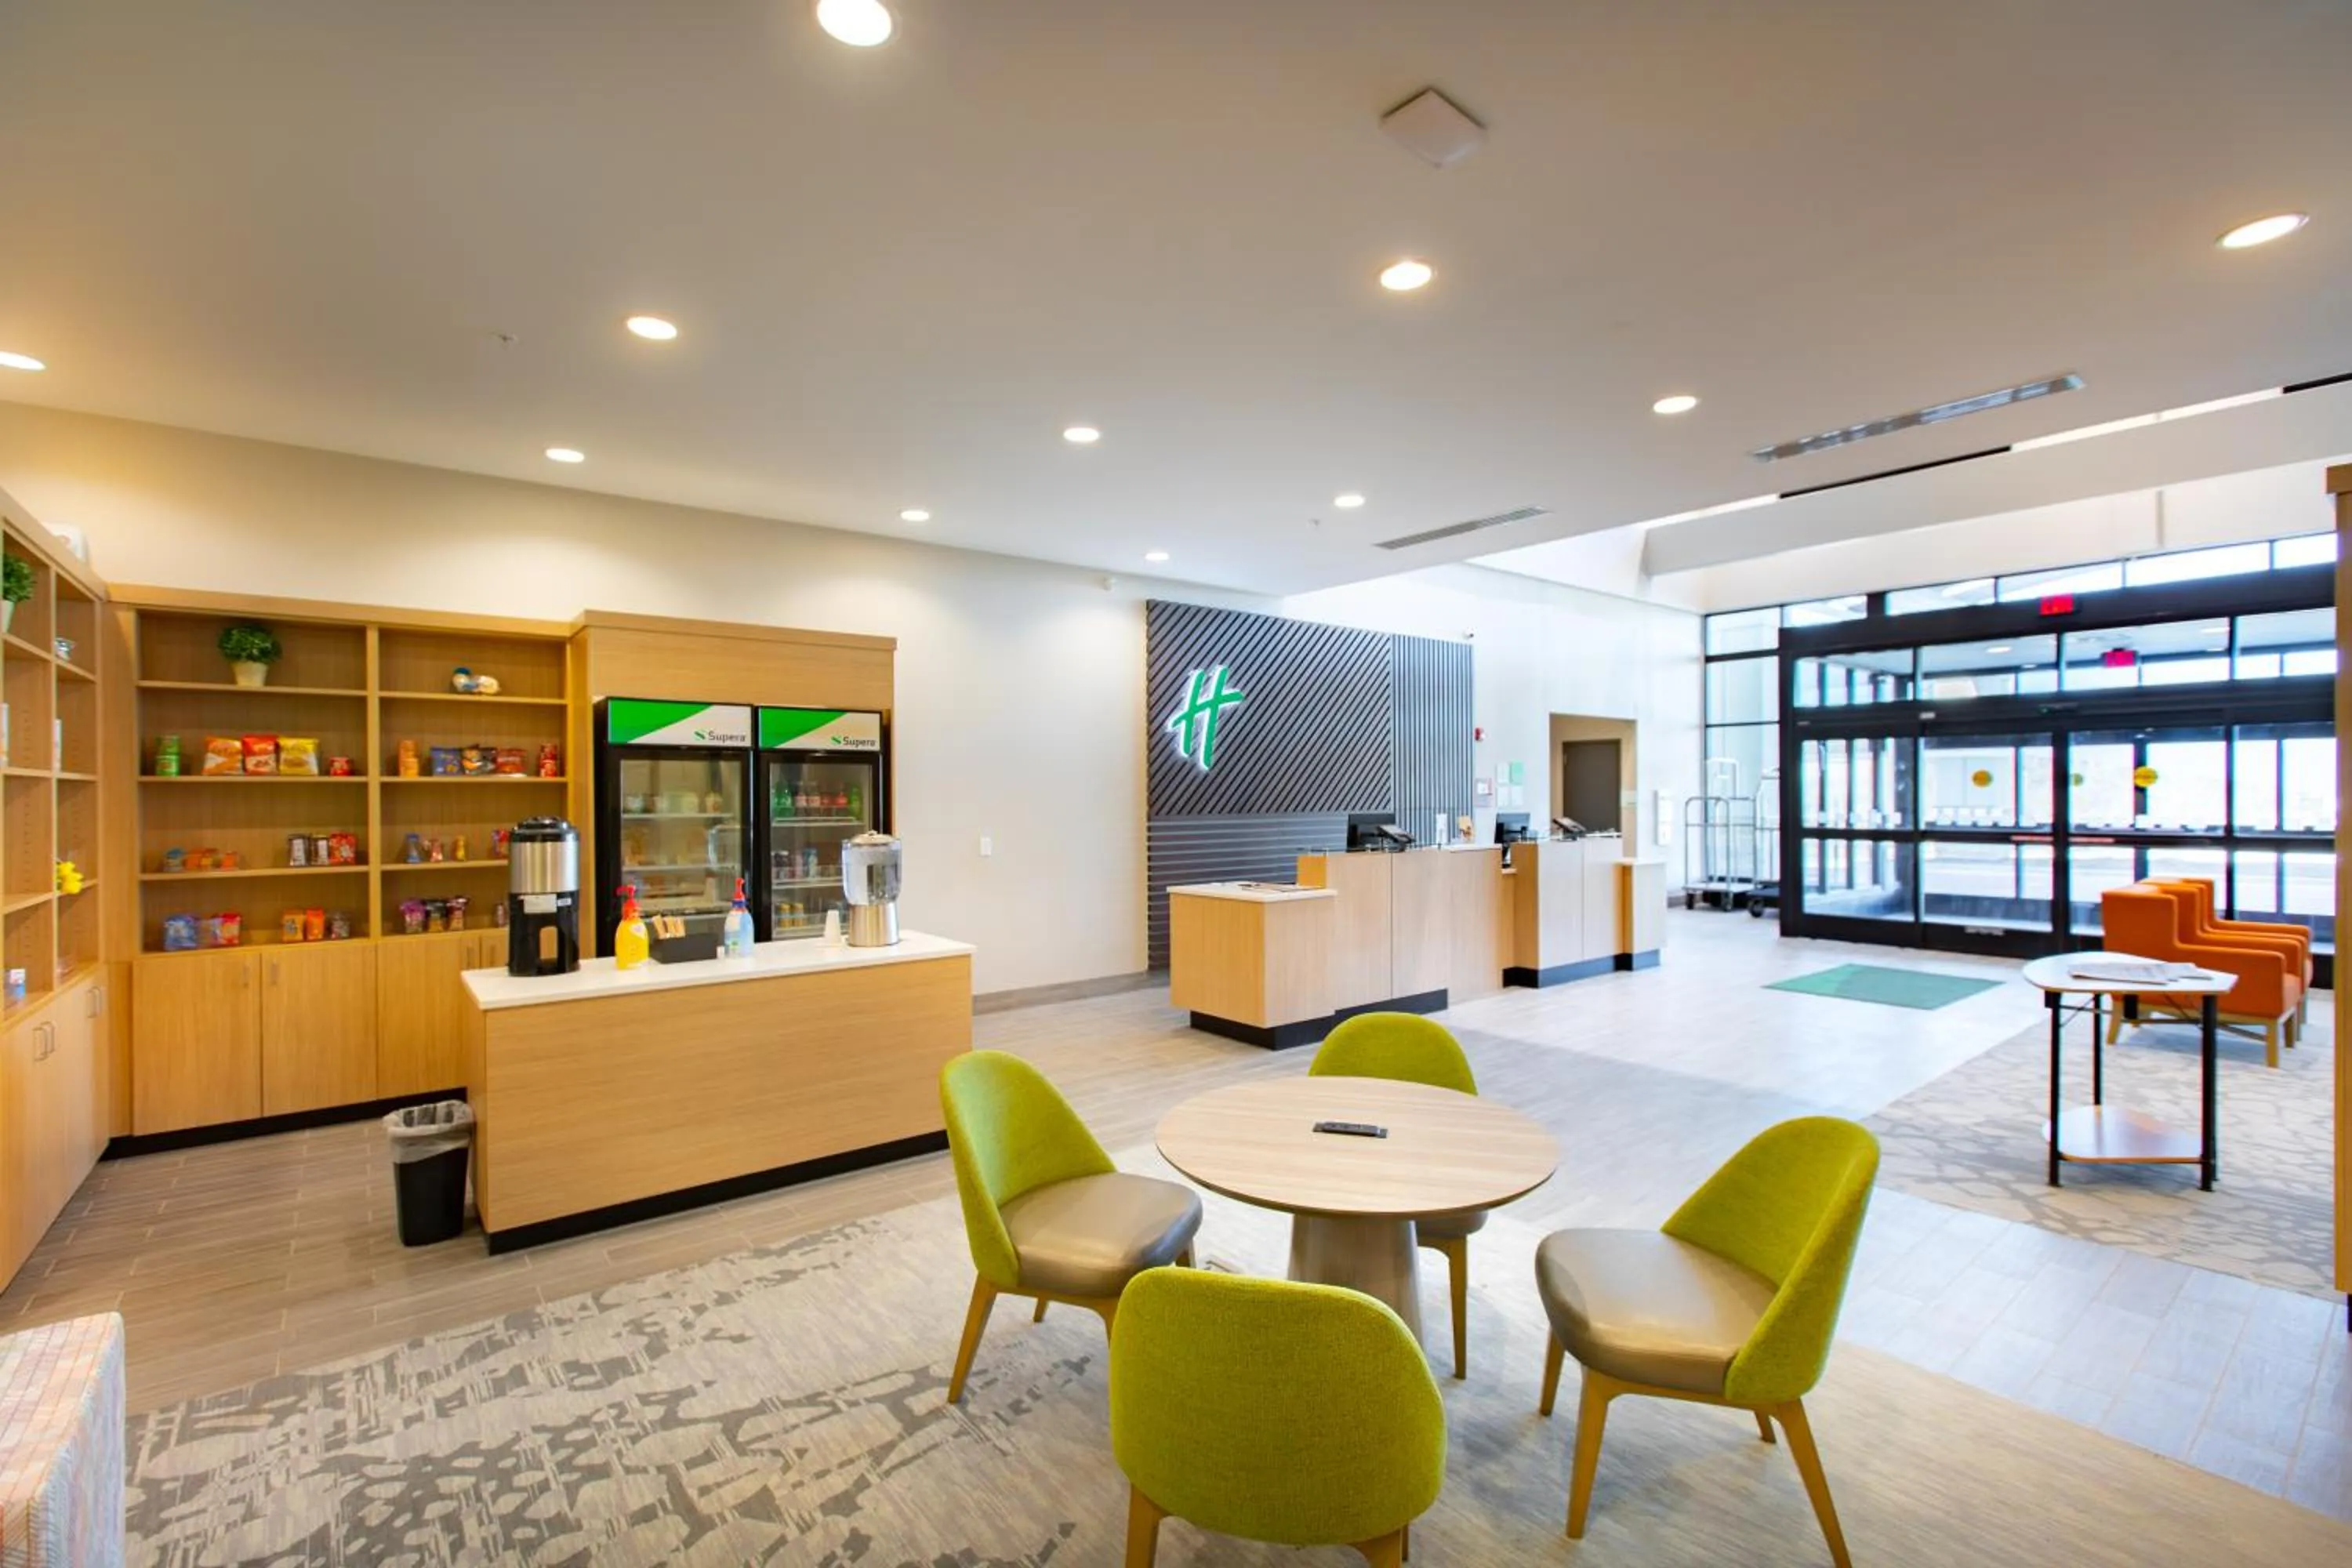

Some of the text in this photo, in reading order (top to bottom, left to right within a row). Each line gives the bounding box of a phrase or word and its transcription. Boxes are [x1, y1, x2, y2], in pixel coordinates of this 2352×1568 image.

[1169, 666, 1245, 770] H
[708, 731, 746, 742] Supera
[843, 736, 876, 748] Supera
